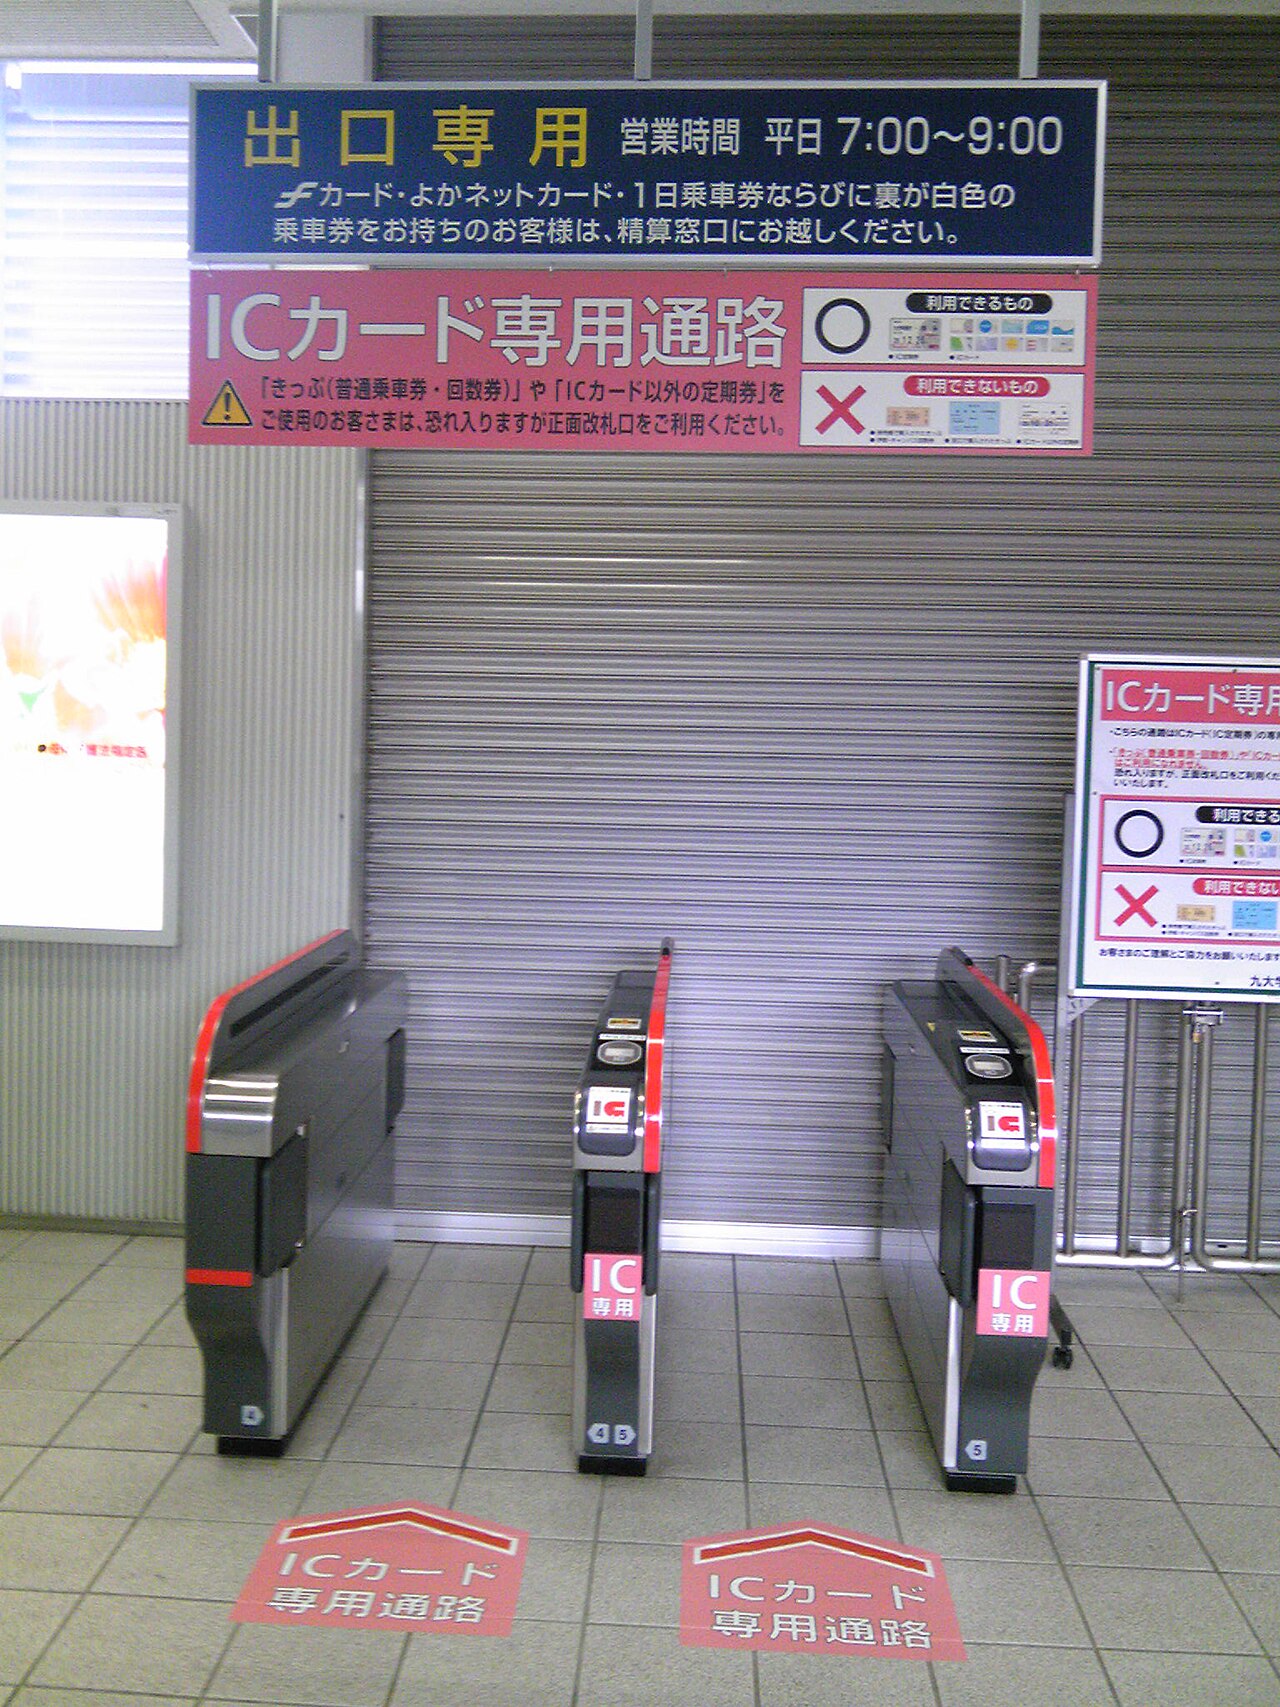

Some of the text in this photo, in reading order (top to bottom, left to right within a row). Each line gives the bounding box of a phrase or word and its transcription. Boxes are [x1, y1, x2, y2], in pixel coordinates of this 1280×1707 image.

[244, 105, 588, 168] 出口専用
[620, 117, 741, 156] 営業時間
[764, 118, 822, 156] 平日
[273, 217, 958, 245] 乗車券をお持ちのお客様は、精算窓口にお越しください。
[927, 294, 1034, 312] 利用できるもの
[206, 292, 788, 369] ICカード専用通路
[917, 378, 1039, 395] 利用できないもの
[262, 409, 785, 437] ご使用のお客さまは、恐れ入りますが正面改札口をご利用ください。
[592, 1259, 636, 1294] IC
[992, 1274, 1039, 1311] IC
[592, 1297, 634, 1317] 専用
[991, 1313, 1034, 1333] 専用
[279, 1552, 498, 1586] ICカード
[265, 1586, 487, 1624] 専用通路
[709, 1574, 927, 1610] ICカード
[711, 1610, 933, 1650] 専用通路
